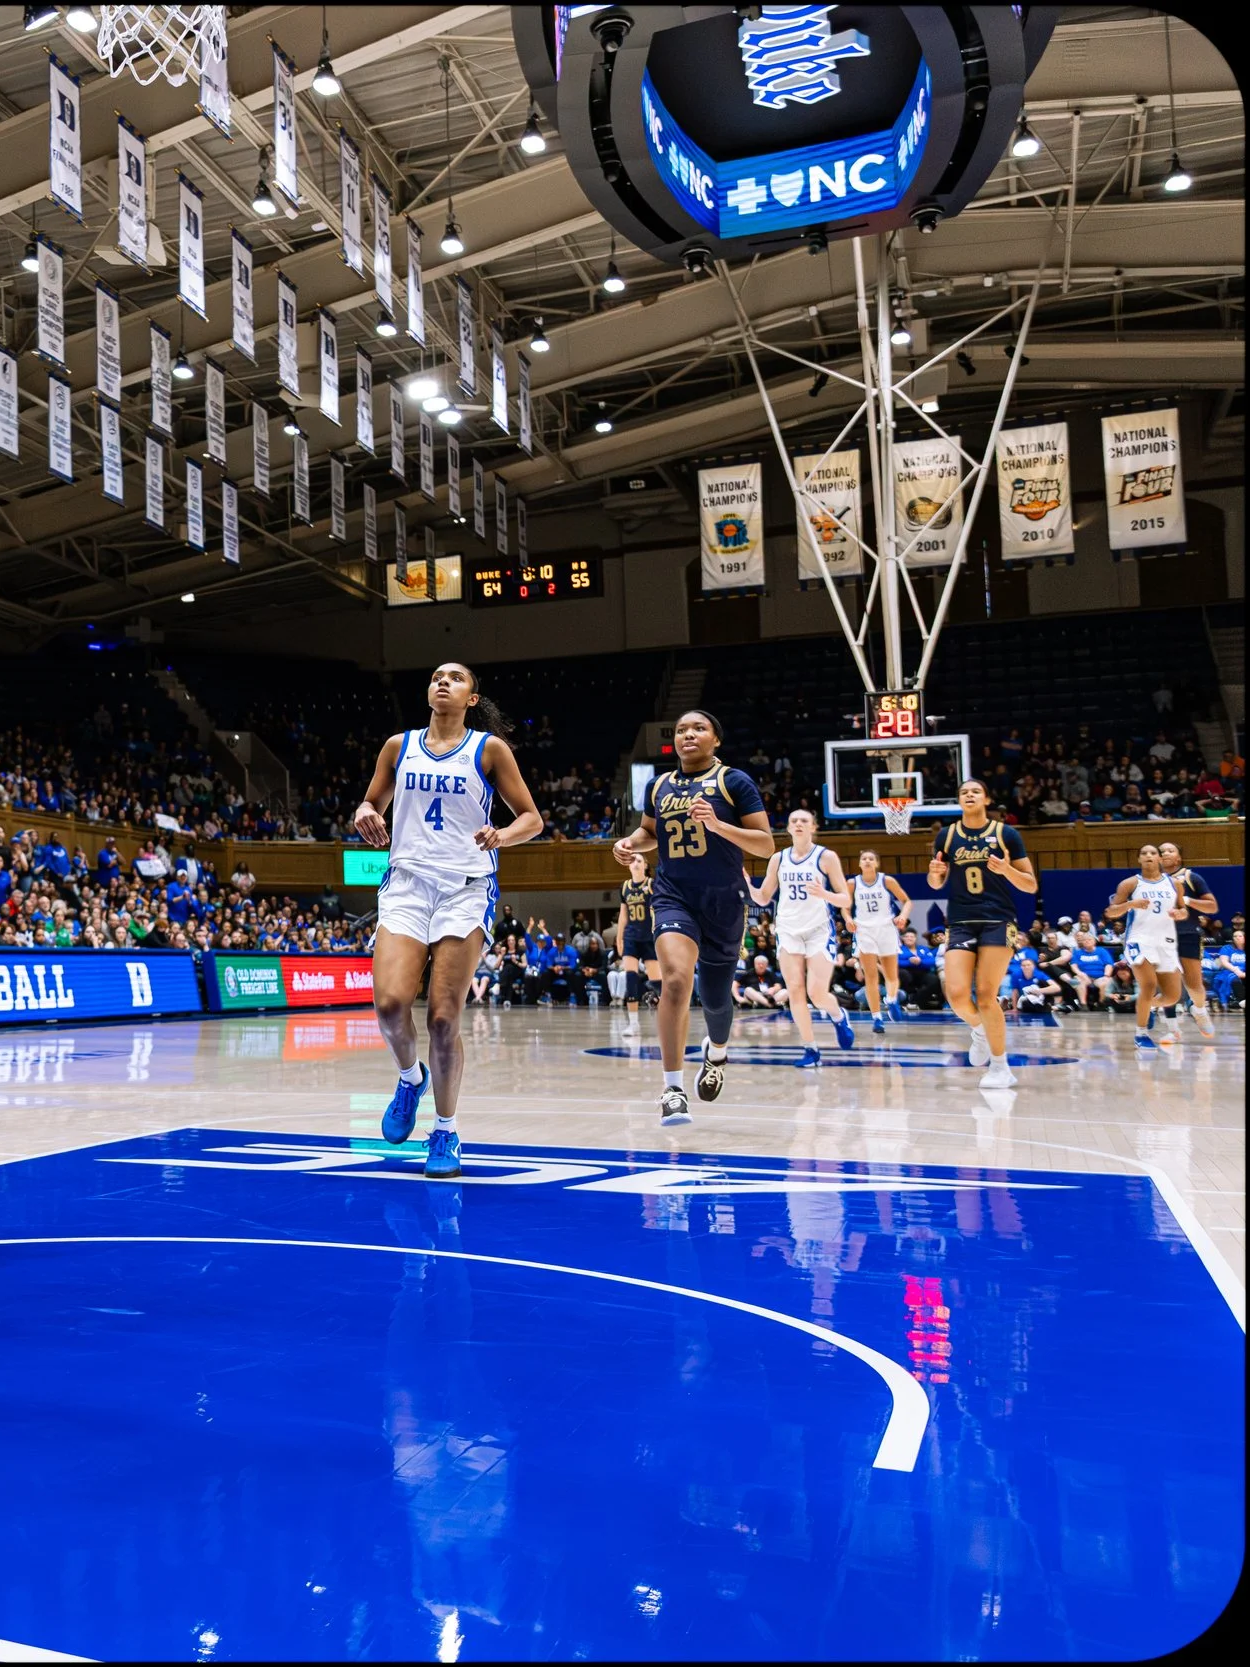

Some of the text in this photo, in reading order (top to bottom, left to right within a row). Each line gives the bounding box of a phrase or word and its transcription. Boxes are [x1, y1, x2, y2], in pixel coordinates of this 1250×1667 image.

[738, 5, 871, 109] uke
[689, 160, 714, 209] NC
[809, 153, 886, 202] NC
[1114, 426, 1168, 443] NATIONAL
[1006, 441, 1057, 457] NATIONAL
[1108, 440, 1177, 459] CHAMPIONS
[1001, 453, 1065, 471] CHAMPIONS
[804, 467, 850, 481] NTIONAL
[707, 479, 752, 494] NATIONAL
[805, 478, 857, 496] HAMPIONS
[1025, 478, 1060, 492] FINAL
[702, 491, 758, 508] CHAMPIONS
[1011, 488, 1060, 507] FOUR
[1131, 517, 1165, 531] 2015
[1022, 528, 1055, 541] 2010
[916, 539, 947, 553] 2001
[823, 550, 846, 563] 992
[475, 570, 501, 580] DUKE
[720, 561, 748, 574] 1991
[571, 572, 590, 588] 55
[483, 582, 502, 597] 64
[881, 694, 918, 711] 6:10
[877, 711, 914, 737] 28
[405, 772, 467, 795] DUKE
[658, 791, 704, 813] Iris
[424, 798, 444, 831] 4
[665, 818, 708, 858] 23
[953, 845, 990, 861] Irish
[361, 861, 390, 874] Ube
[782, 872, 813, 882] DUKE
[965, 866, 984, 894] 8
[788, 884, 808, 901] 35
[859, 892, 883, 900] DUKE
[1141, 890, 1171, 900] DUKE
[629, 904, 646, 921] 30
[866, 900, 879, 913] 12
[1152, 900, 1162, 915] 3
